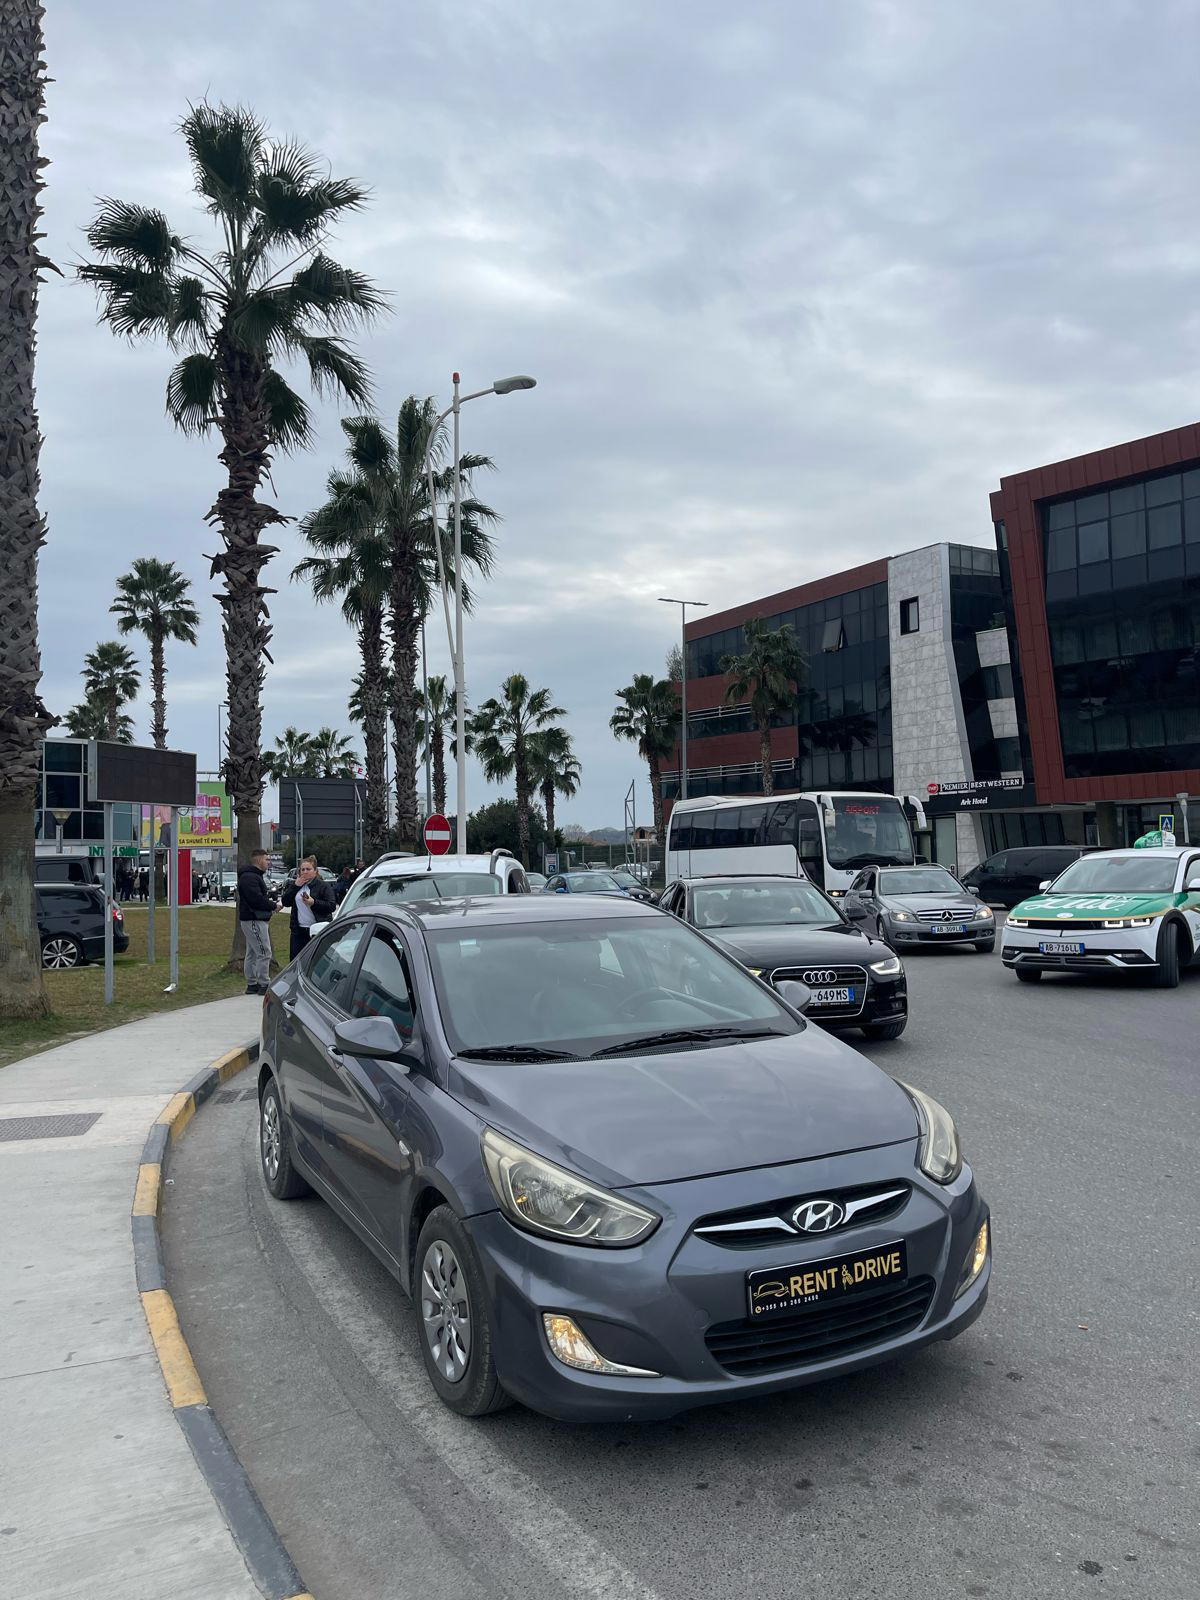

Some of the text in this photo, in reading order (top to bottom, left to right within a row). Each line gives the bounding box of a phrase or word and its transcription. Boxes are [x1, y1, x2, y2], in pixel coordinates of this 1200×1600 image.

[940, 782, 968, 791] PREMIER
[988, 779, 1020, 787] WESTERN
[960, 797, 988, 806] Ark Hotel
[790, 1267, 838, 1297] RENT
[853, 1252, 901, 1283] DRIVE
